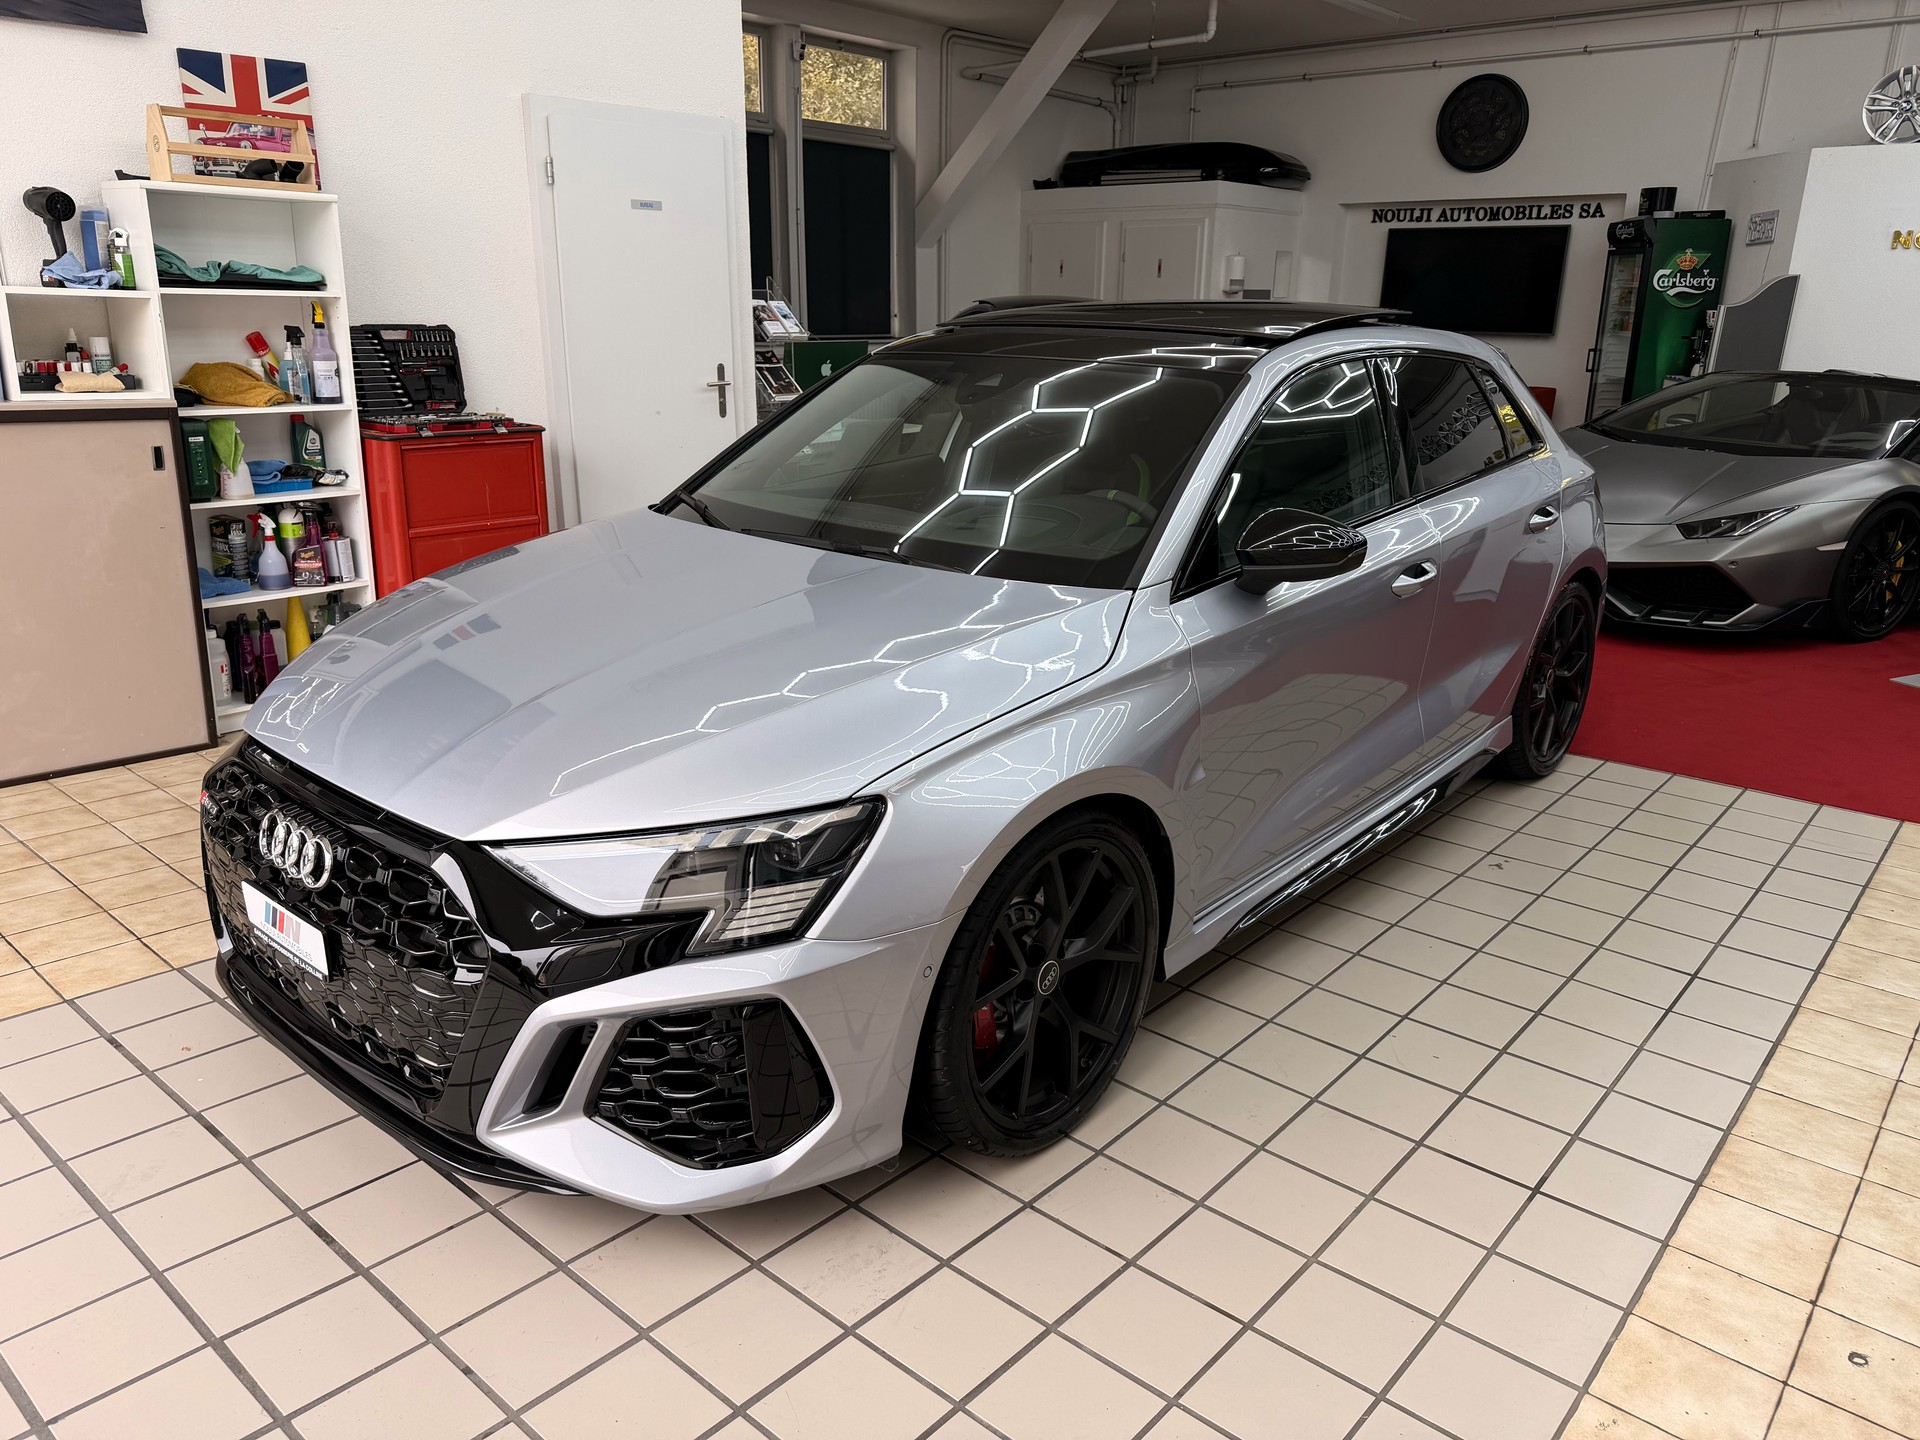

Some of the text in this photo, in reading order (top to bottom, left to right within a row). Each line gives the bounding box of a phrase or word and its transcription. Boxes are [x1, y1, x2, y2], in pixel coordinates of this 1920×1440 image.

[1371, 202, 1605, 223] NOUIJI AUTOMOBILES SA
[1616, 224, 1635, 238] Carlsberg
[1653, 269, 1717, 292] Carlsberg
